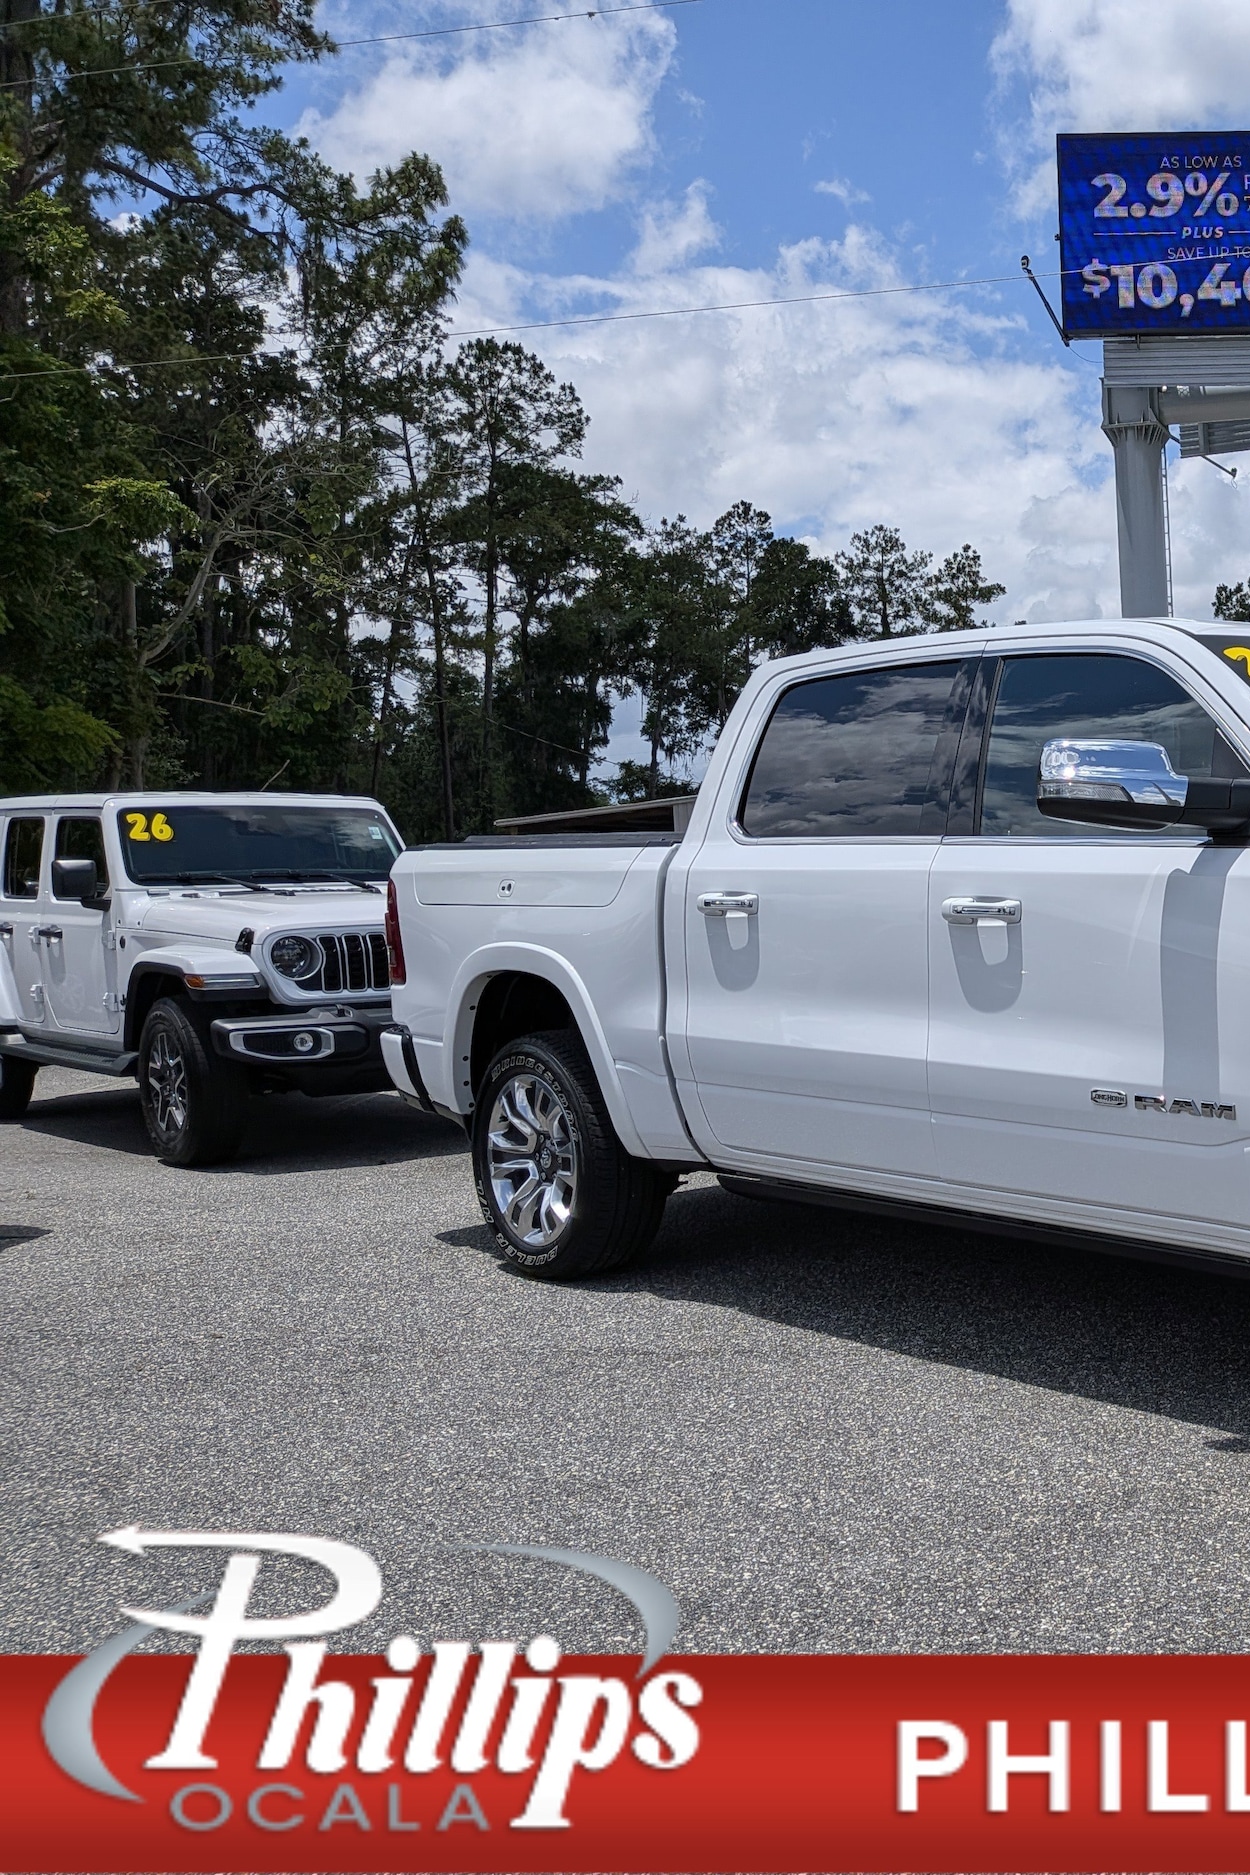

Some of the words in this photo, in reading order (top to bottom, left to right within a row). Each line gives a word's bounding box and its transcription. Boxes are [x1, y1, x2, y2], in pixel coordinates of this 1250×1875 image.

[1160, 156, 1180, 169] AS
[1184, 155, 1219, 169] LOW
[1222, 155, 1243, 168] AS
[1090, 172, 1241, 219] 2.9%
[1181, 226, 1225, 240] PLUS
[1167, 246, 1205, 260] SAVE
[1209, 246, 1230, 259] UP
[126, 812, 175, 841] 26
[490, 1055, 579, 1143] BRIDGESTONE
[1134, 1093, 1237, 1121] RAM
[495, 1232, 559, 1266] DUELER
